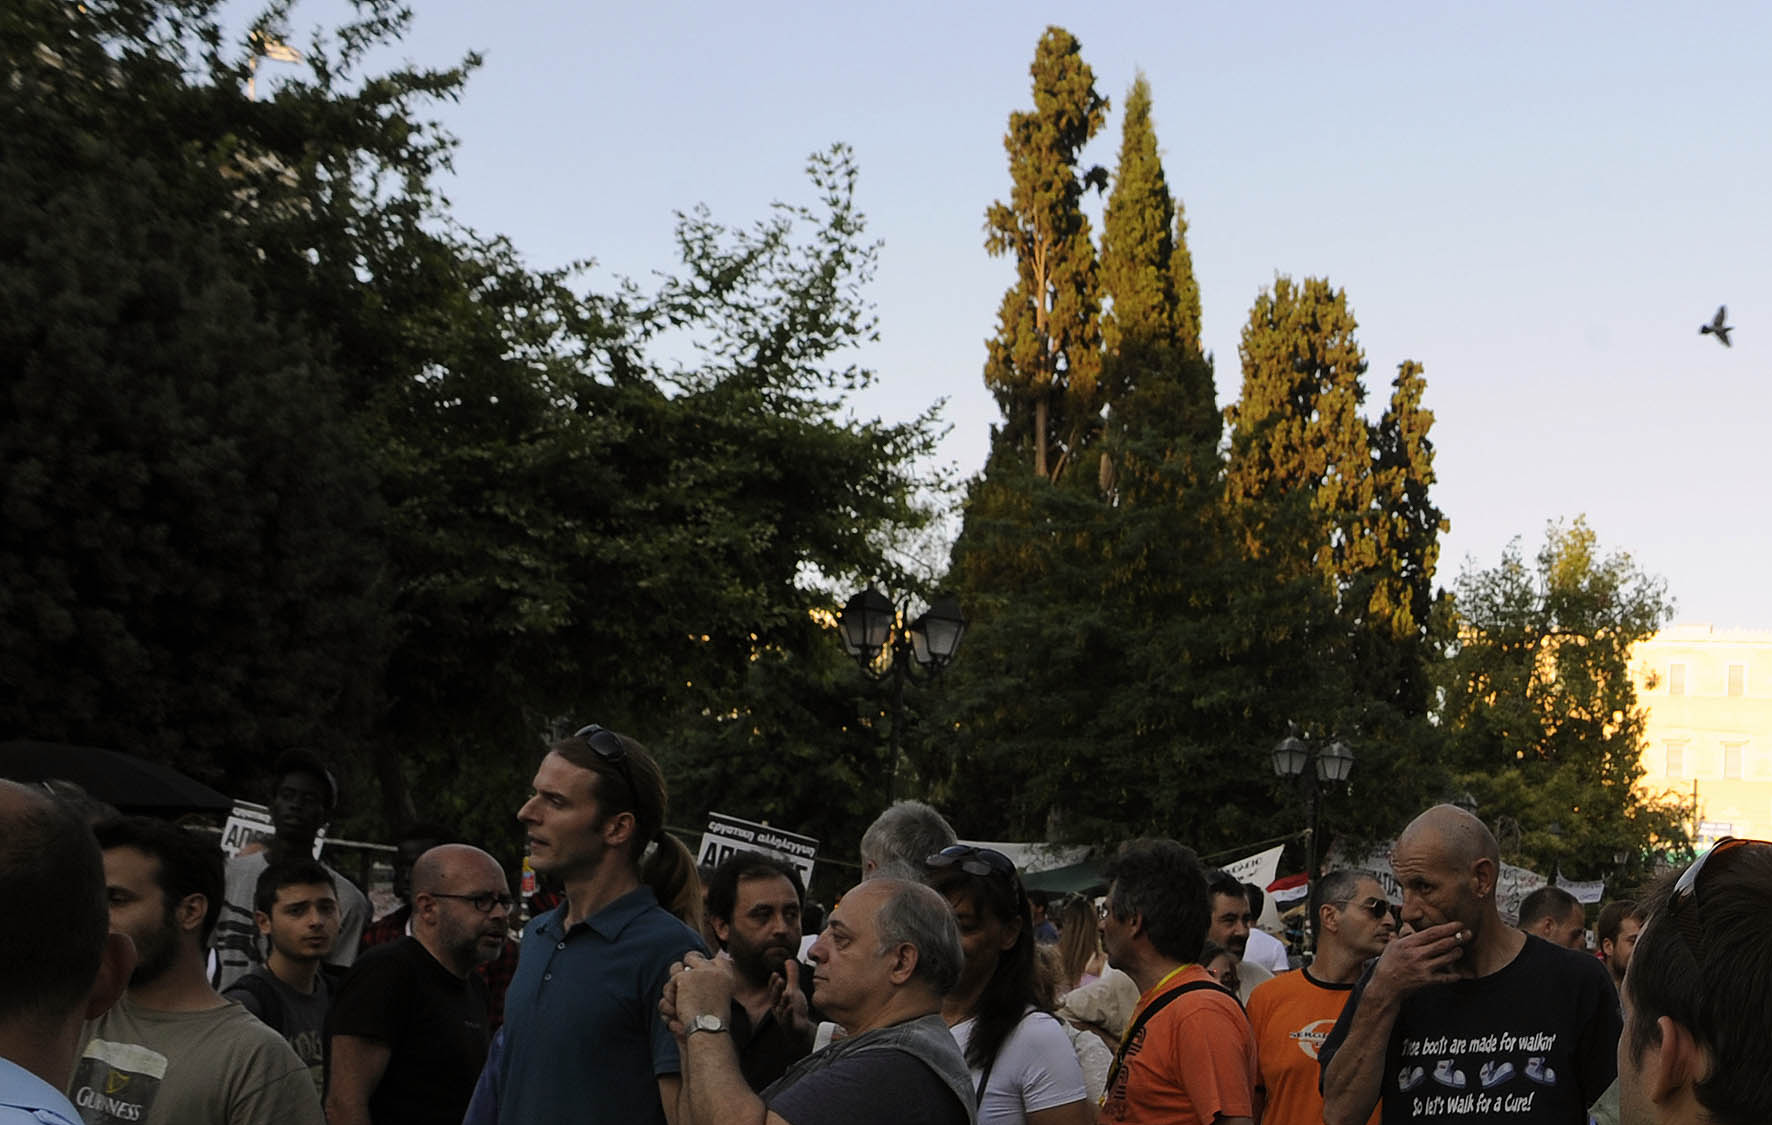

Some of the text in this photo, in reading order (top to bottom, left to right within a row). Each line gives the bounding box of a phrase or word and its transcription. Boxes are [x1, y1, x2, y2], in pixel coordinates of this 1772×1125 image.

[1421, 1035, 1449, 1056] boots
[1449, 1037, 1468, 1055] are
[1469, 1033, 1498, 1055] made
[1499, 1031, 1516, 1053] for
[76, 1086, 144, 1123] GUINNESS
[1411, 1096, 1424, 1118] So
[1476, 1092, 1493, 1115] for
[1493, 1099, 1503, 1114] a
[1504, 1090, 1537, 1113] Cure!
